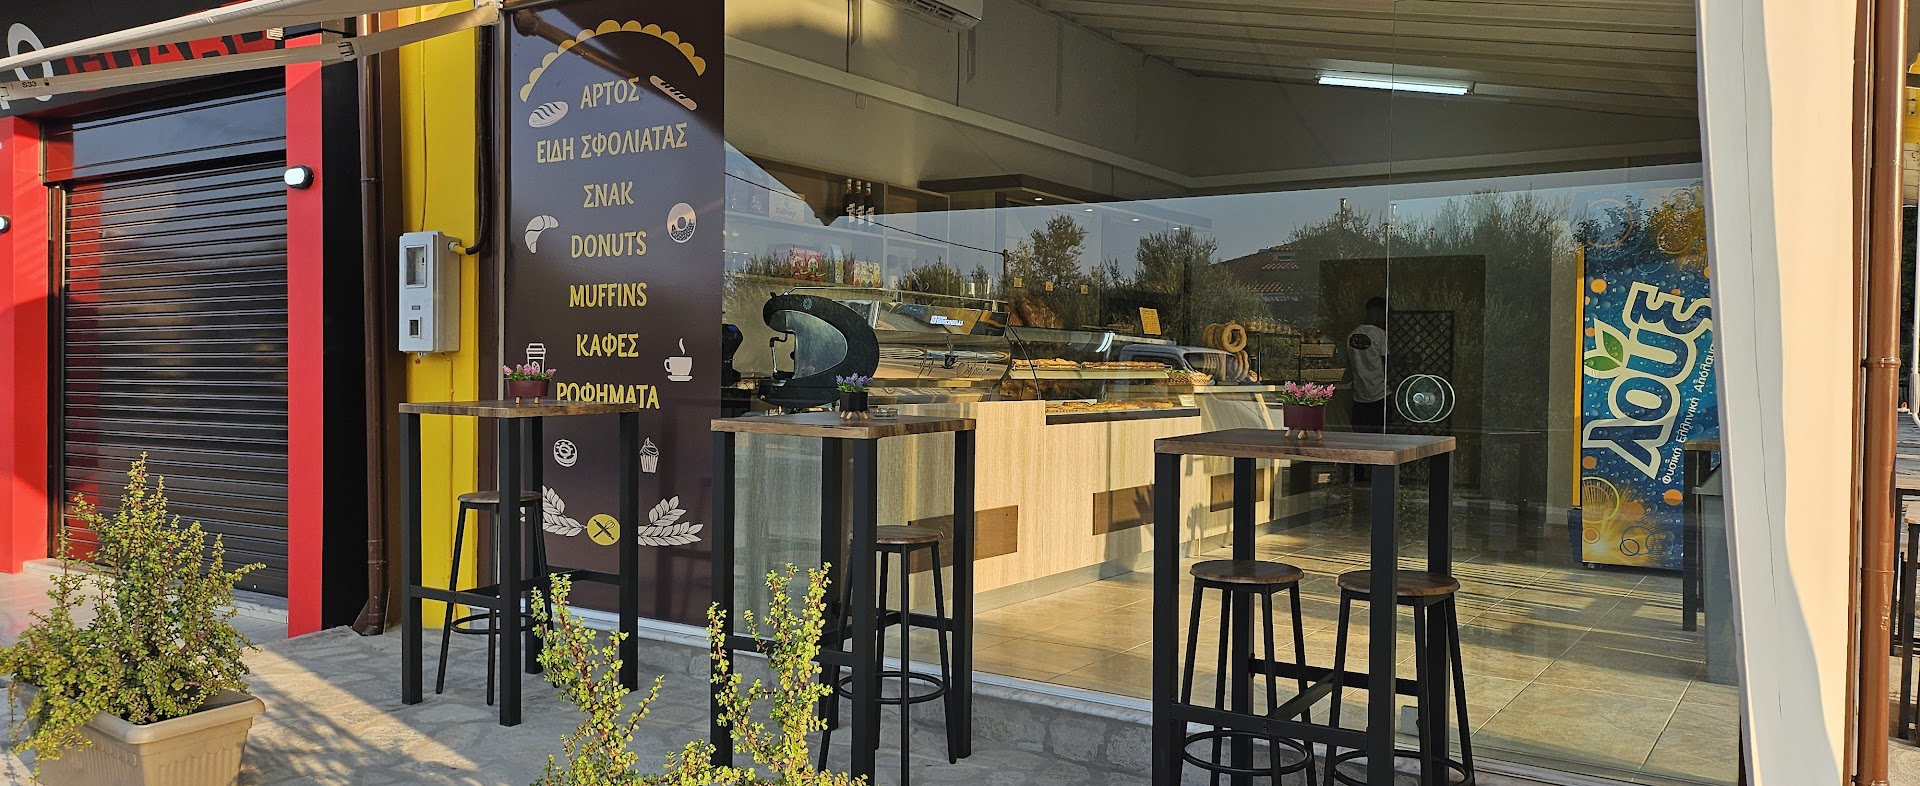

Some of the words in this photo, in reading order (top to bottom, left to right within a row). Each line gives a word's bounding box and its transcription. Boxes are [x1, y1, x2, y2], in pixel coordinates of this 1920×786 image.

[580, 76, 640, 109] ΑΡΤΟΣ
[537, 137, 574, 164] ΕΙΔΗ
[581, 122, 688, 159] ΣΦΟΛΙΑΤΑΣ
[583, 181, 634, 208] ΣΝΑΚ
[571, 231, 647, 258] DONUTS
[569, 282, 647, 308] MUFFINS
[576, 332, 639, 358] ΚΑΦΕΣ
[556, 382, 660, 409] ΡΟΦΗΜΑΤΑ
